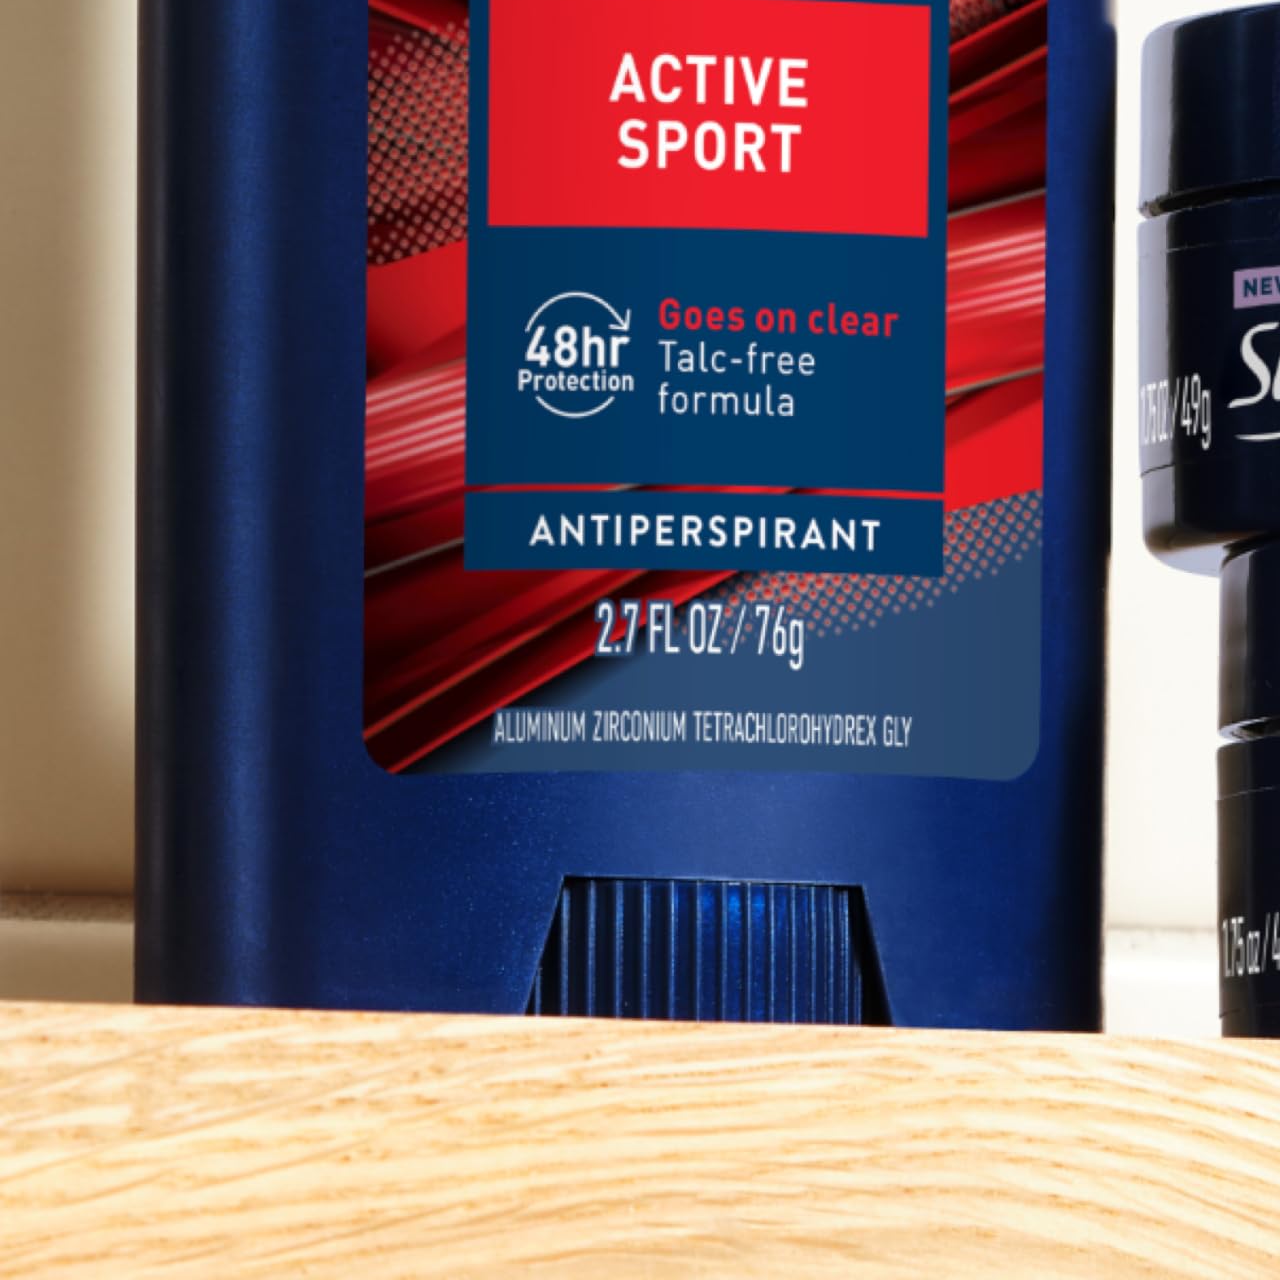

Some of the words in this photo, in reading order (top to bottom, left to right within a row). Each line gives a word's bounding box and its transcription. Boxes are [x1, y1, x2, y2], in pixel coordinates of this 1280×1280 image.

[609, 51, 809, 107] ACTIVE
[617, 118, 802, 173] SPORT
[658, 298, 745, 333] Goes
[756, 306, 797, 335] on
[808, 302, 897, 338] clear
[525, 325, 630, 369] 48hr
[658, 340, 816, 377] Talc-free
[517, 369, 634, 394] Protection
[658, 383, 795, 417] formula
[1181, 373, 1211, 449] 49g
[529, 514, 881, 552] ANTIPERSPIRANT
[596, 603, 636, 654] 2.7
[648, 603, 679, 654] FL
[688, 604, 723, 655] OZ
[730, 604, 748, 655] /
[755, 605, 804, 670] 76g
[494, 709, 586, 744] ALUMINUM
[593, 710, 687, 744] ZIRCONIUM
[693, 710, 877, 747] TETRACHLOROHYDREX
[883, 716, 913, 748] GLY
